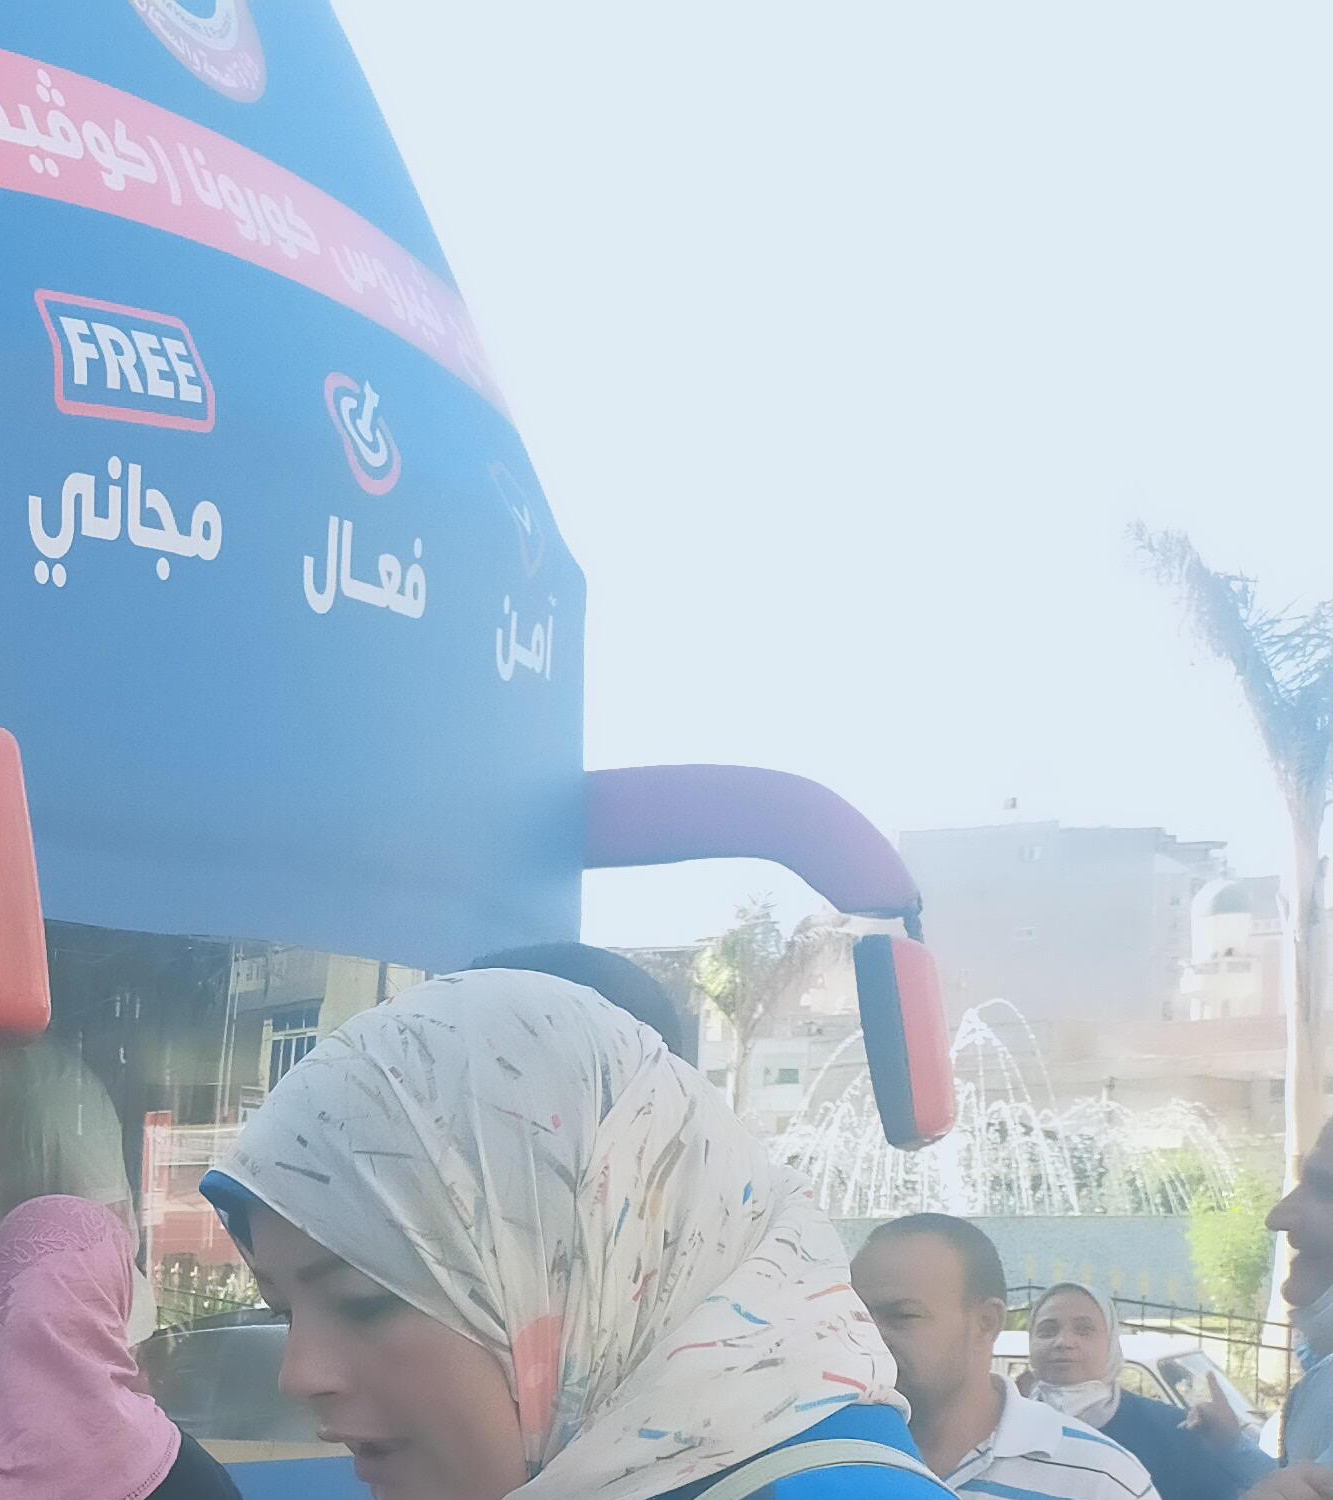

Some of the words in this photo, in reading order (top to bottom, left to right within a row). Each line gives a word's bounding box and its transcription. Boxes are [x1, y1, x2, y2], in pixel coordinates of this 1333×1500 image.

[177, 141, 321, 259] كورونا
[59, 316, 203, 403] FREE
[28, 456, 222, 587] مجاني
